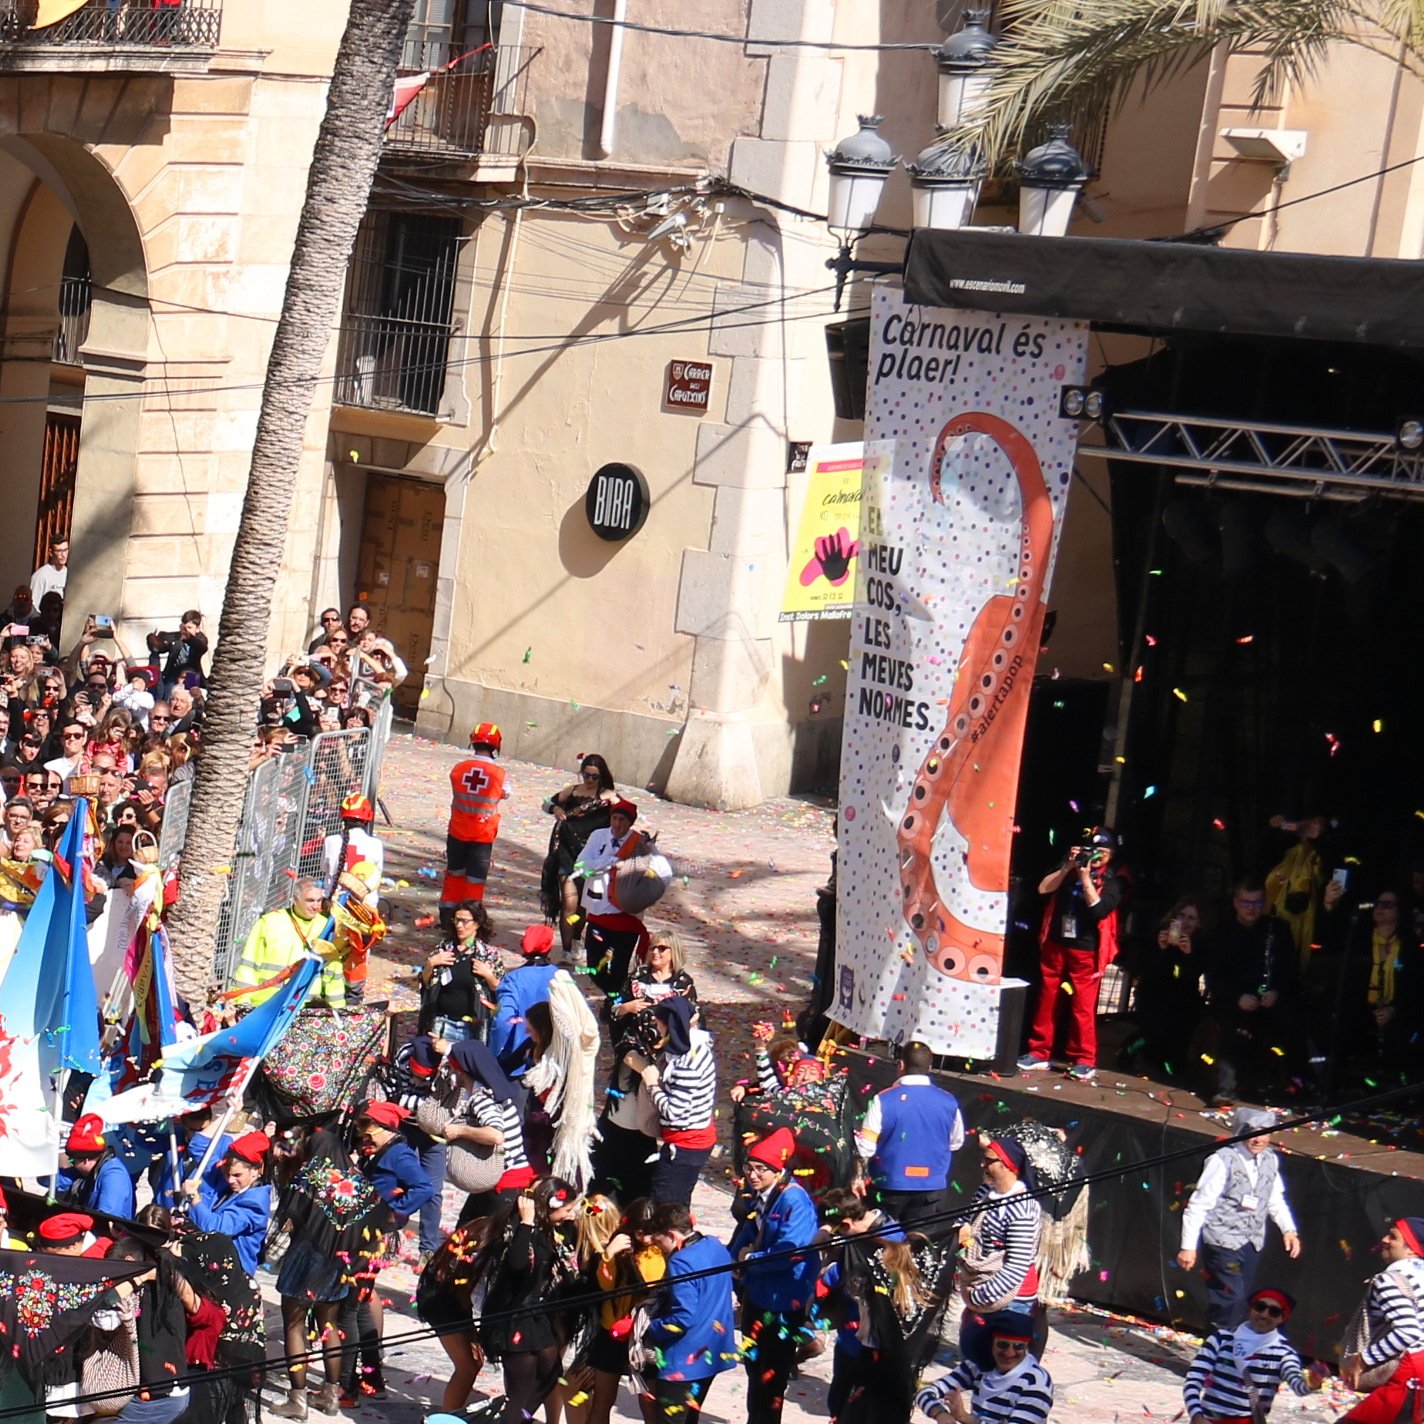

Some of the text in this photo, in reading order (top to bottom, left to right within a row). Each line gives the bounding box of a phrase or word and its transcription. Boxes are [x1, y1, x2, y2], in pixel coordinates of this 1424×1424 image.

[881, 313, 1046, 359] Carnaval és
[874, 347, 961, 385] plaer!
[867, 506, 883, 536] EL
[867, 541, 904, 576] MEU
[866, 576, 902, 617] COS,
[864, 616, 891, 650] LES
[860, 651, 914, 692] MEVES
[858, 687, 935, 732] NORMES.
[970, 653, 1024, 745] #alertapop
